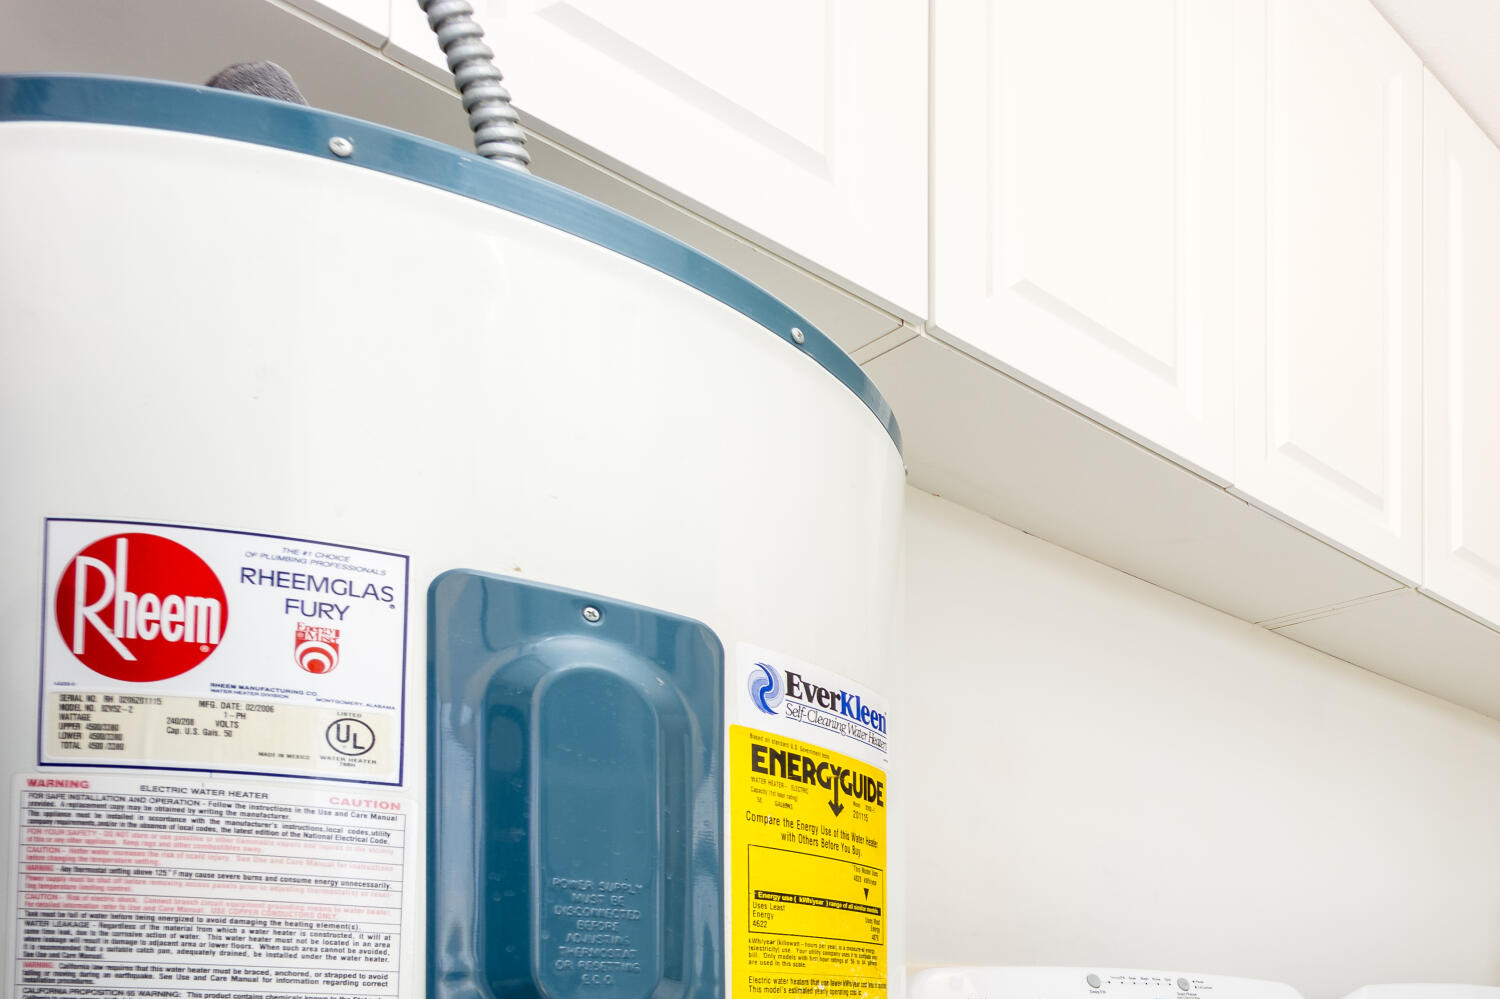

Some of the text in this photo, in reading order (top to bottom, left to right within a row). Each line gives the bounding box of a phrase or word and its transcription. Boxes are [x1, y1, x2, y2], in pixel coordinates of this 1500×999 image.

[283, 547, 299, 555] THE
[315, 552, 350, 563] CHOICE
[260, 553, 307, 565] PLUMBING
[311, 559, 386, 576] PROFESSIONALS
[240, 566, 394, 603] RHEEMGLAS
[73, 537, 221, 661] Rheem
[285, 598, 350, 621] FURY
[210, 682, 236, 690] RHEEM
[238, 684, 304, 696] MANUFACTURING
[785, 669, 886, 735] EverKleen
[59, 713, 92, 722] WATTAGE
[786, 703, 846, 736] Self-Cleaning
[848, 722, 868, 742] Water
[215, 720, 239, 729] VOLTS
[320, 754, 346, 762] WATER
[348, 757, 377, 766] HEATER
[26, 778, 90, 789] WARNING
[139, 785, 269, 799] ELECTRIC WATER HEATER
[68, 794, 126, 802] INSTALLATION
[148, 797, 200, 806] OPERATION
[248, 804, 292, 812] instructions
[370, 813, 398, 821] Manual
[328, 796, 401, 811] CAUTION
[200, 808, 223, 817] writing
[240, 810, 290, 819] manufacturer.
[225, 819, 278, 829] manufacturer's
[745, 810, 780, 827] Compare
[783, 816, 794, 829] the
[796, 819, 819, 837] Energy
[820, 825, 832, 837] Use
[834, 828, 839, 837] of
[840, 828, 850, 841] this
[851, 831, 865, 845] Water
[303, 832, 333, 841] National
[335, 835, 368, 844] Electrical
[781, 831, 863, 859] with Others Before You Buy.
[243, 873, 262, 881] burns
[280, 876, 311, 884] consume
[315, 878, 339, 886] energy
[341, 879, 393, 889] unnecessarily.
[610, 895, 625, 906] BE
[757, 890, 780, 903] Energy
[752, 901, 785, 912] Uses Least
[752, 910, 774, 921] Energy
[52, 921, 91, 929] LEAKAGE
[229, 918, 268, 927] damaging
[284, 921, 314, 930] heating
[576, 919, 620, 932] BEFORE
[558, 945, 639, 959] THERMOSTAT
[554, 959, 574, 971] OR
[748, 976, 789, 986] Electric water
[22, 987, 67, 995] CALIFORNIA
[70, 988, 124, 997] PROPOSITION
[138, 990, 182, 998] WARNING:
[204, 992, 231, 999] product
[749, 985, 762, 994] This
[763, 986, 787, 994] model's
[788, 986, 814, 996] estimated
